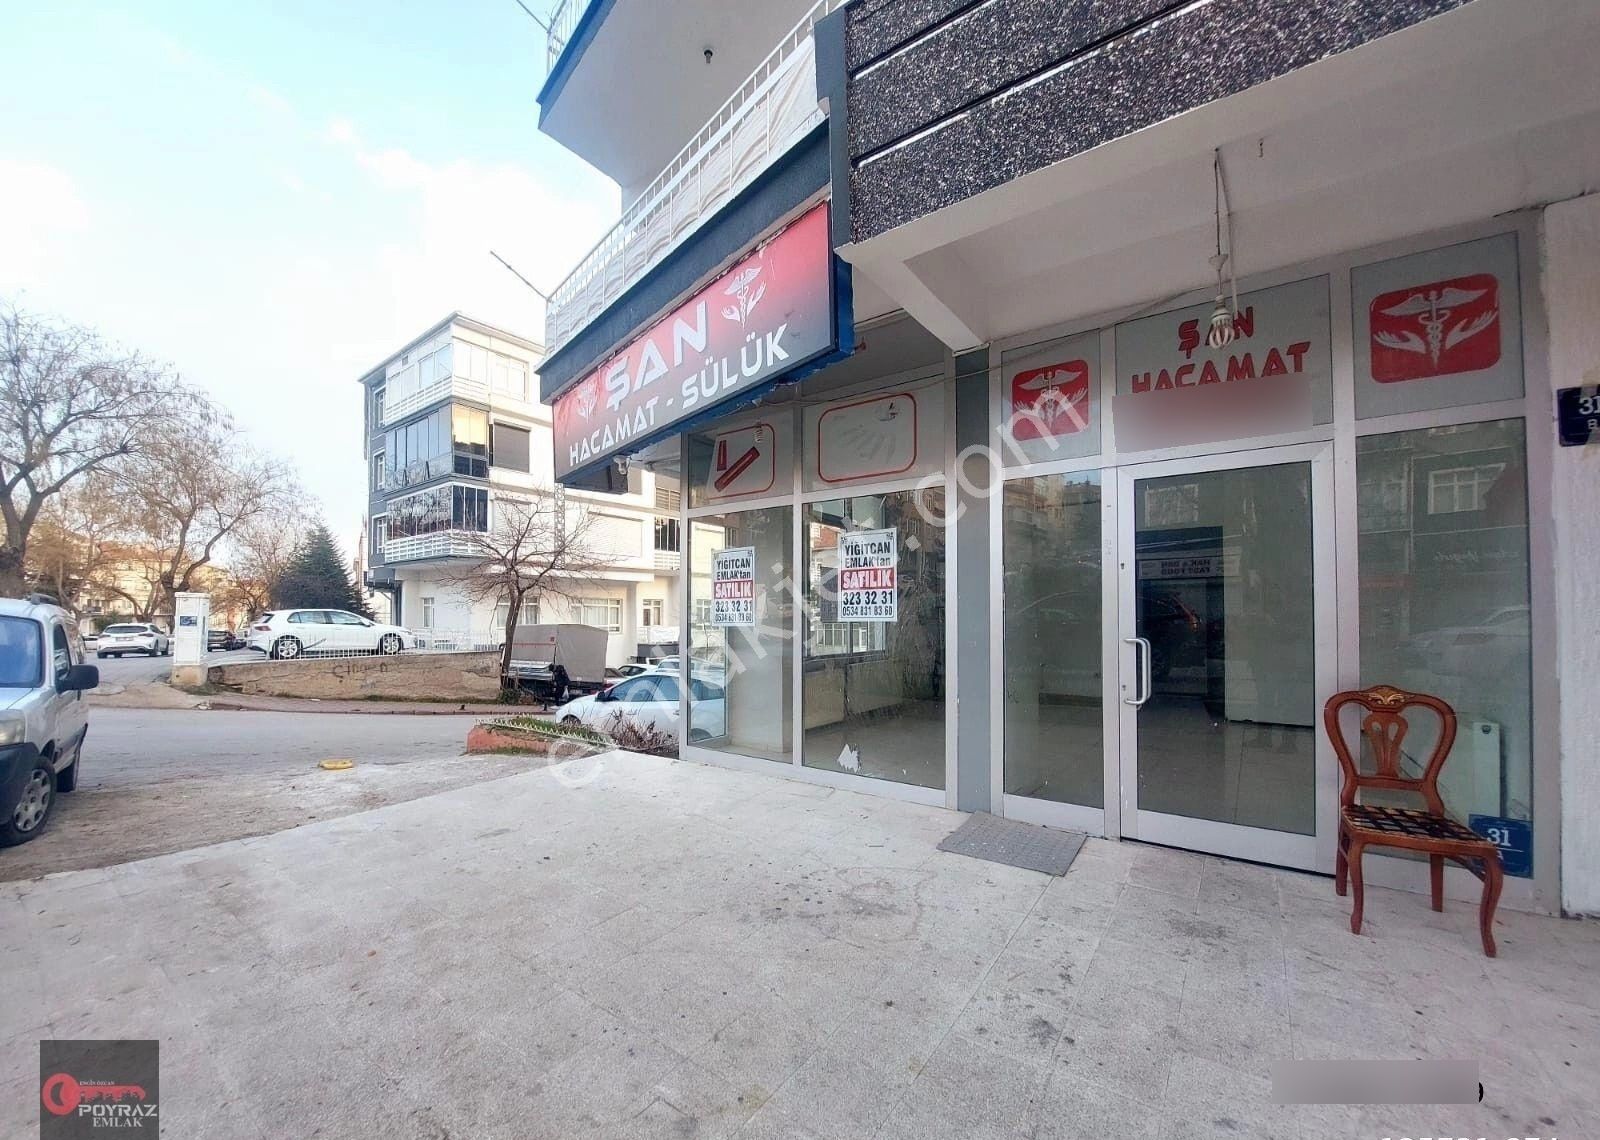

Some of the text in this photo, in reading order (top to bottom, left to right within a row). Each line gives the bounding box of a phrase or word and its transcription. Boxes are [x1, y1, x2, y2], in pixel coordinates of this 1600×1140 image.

[605, 301, 707, 412] ŞAN
[569, 396, 660, 467] HACAMAT
[681, 323, 790, 410] SÜLÜK
[845, 540, 891, 556] YİĞİTCAN
[843, 569, 892, 589] SATILIK
[715, 582, 752, 598] SATILIK
[843, 590, 893, 605] 323 32 31
[716, 601, 729, 612] 323
[732, 601, 741, 612] 32
[843, 606, 858, 616] 0534
[1486, 828, 1512, 847] 31
